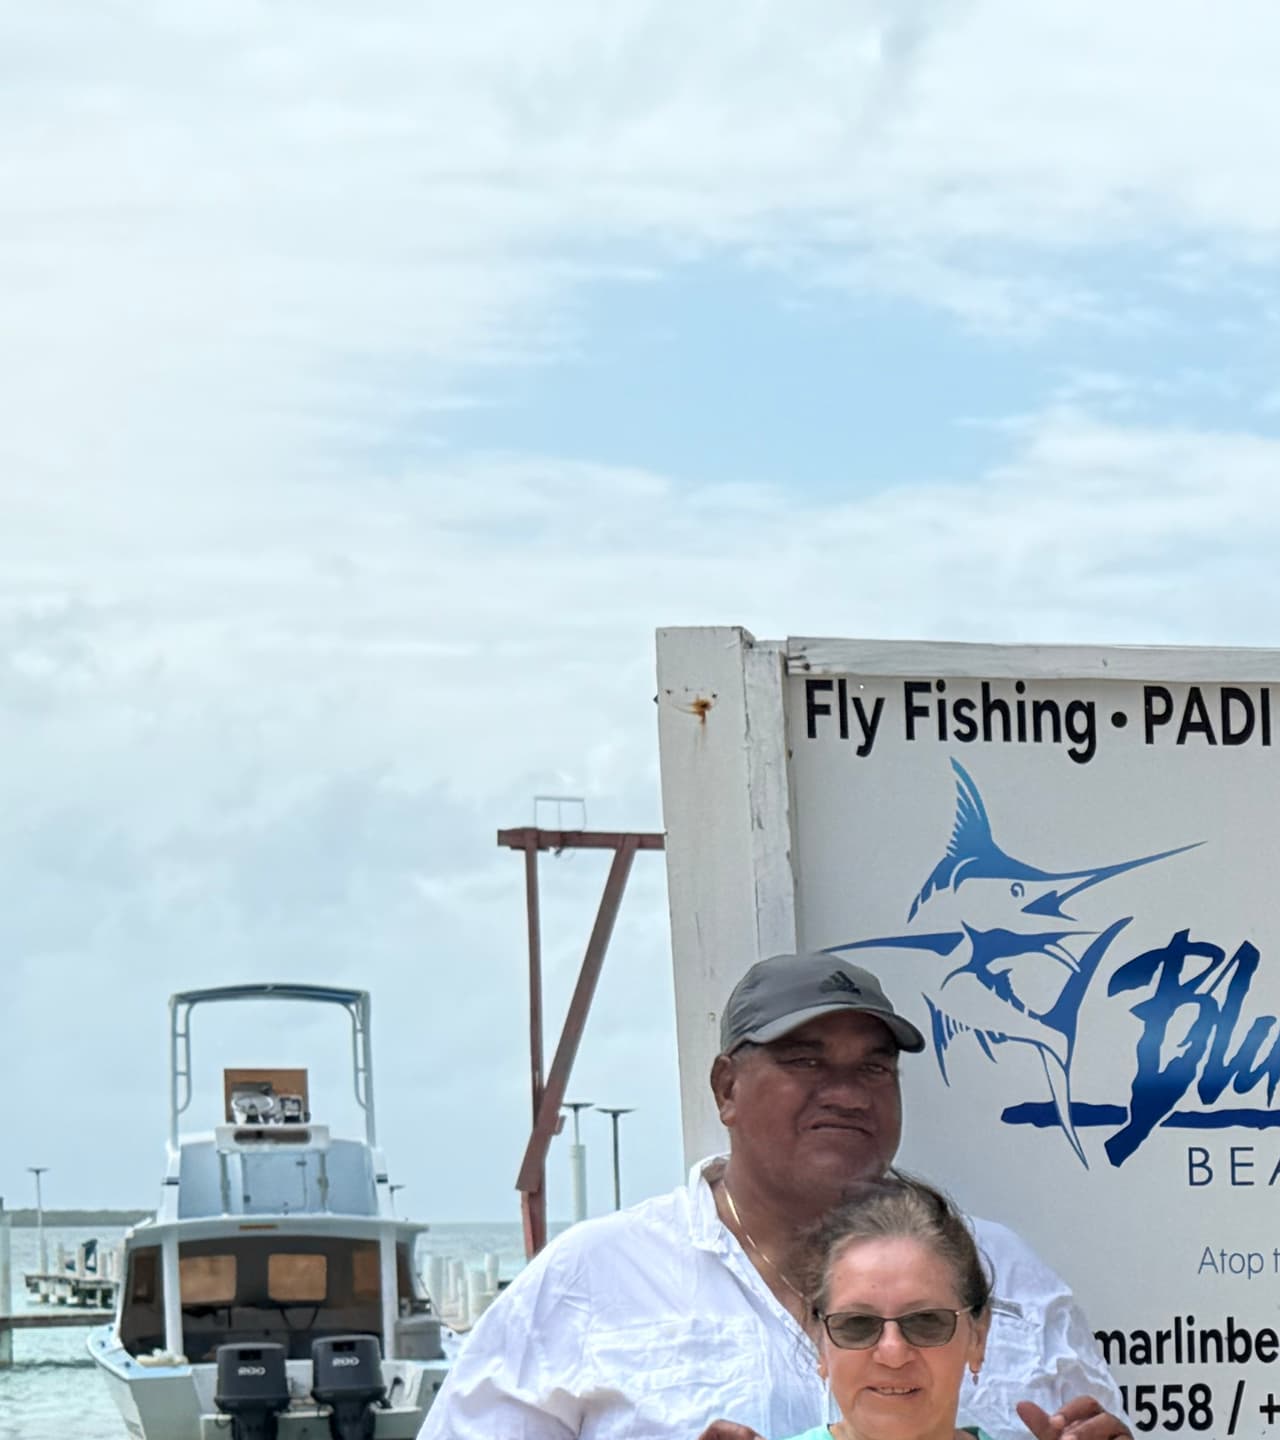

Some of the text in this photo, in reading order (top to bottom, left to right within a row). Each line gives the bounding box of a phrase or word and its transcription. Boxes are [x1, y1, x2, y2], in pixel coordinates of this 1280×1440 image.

[805, 679, 885, 758] Fly
[904, 680, 1097, 764] Fishing
[1143, 686, 1272, 747] PADI
[1197, 1245, 1265, 1280] Atop
